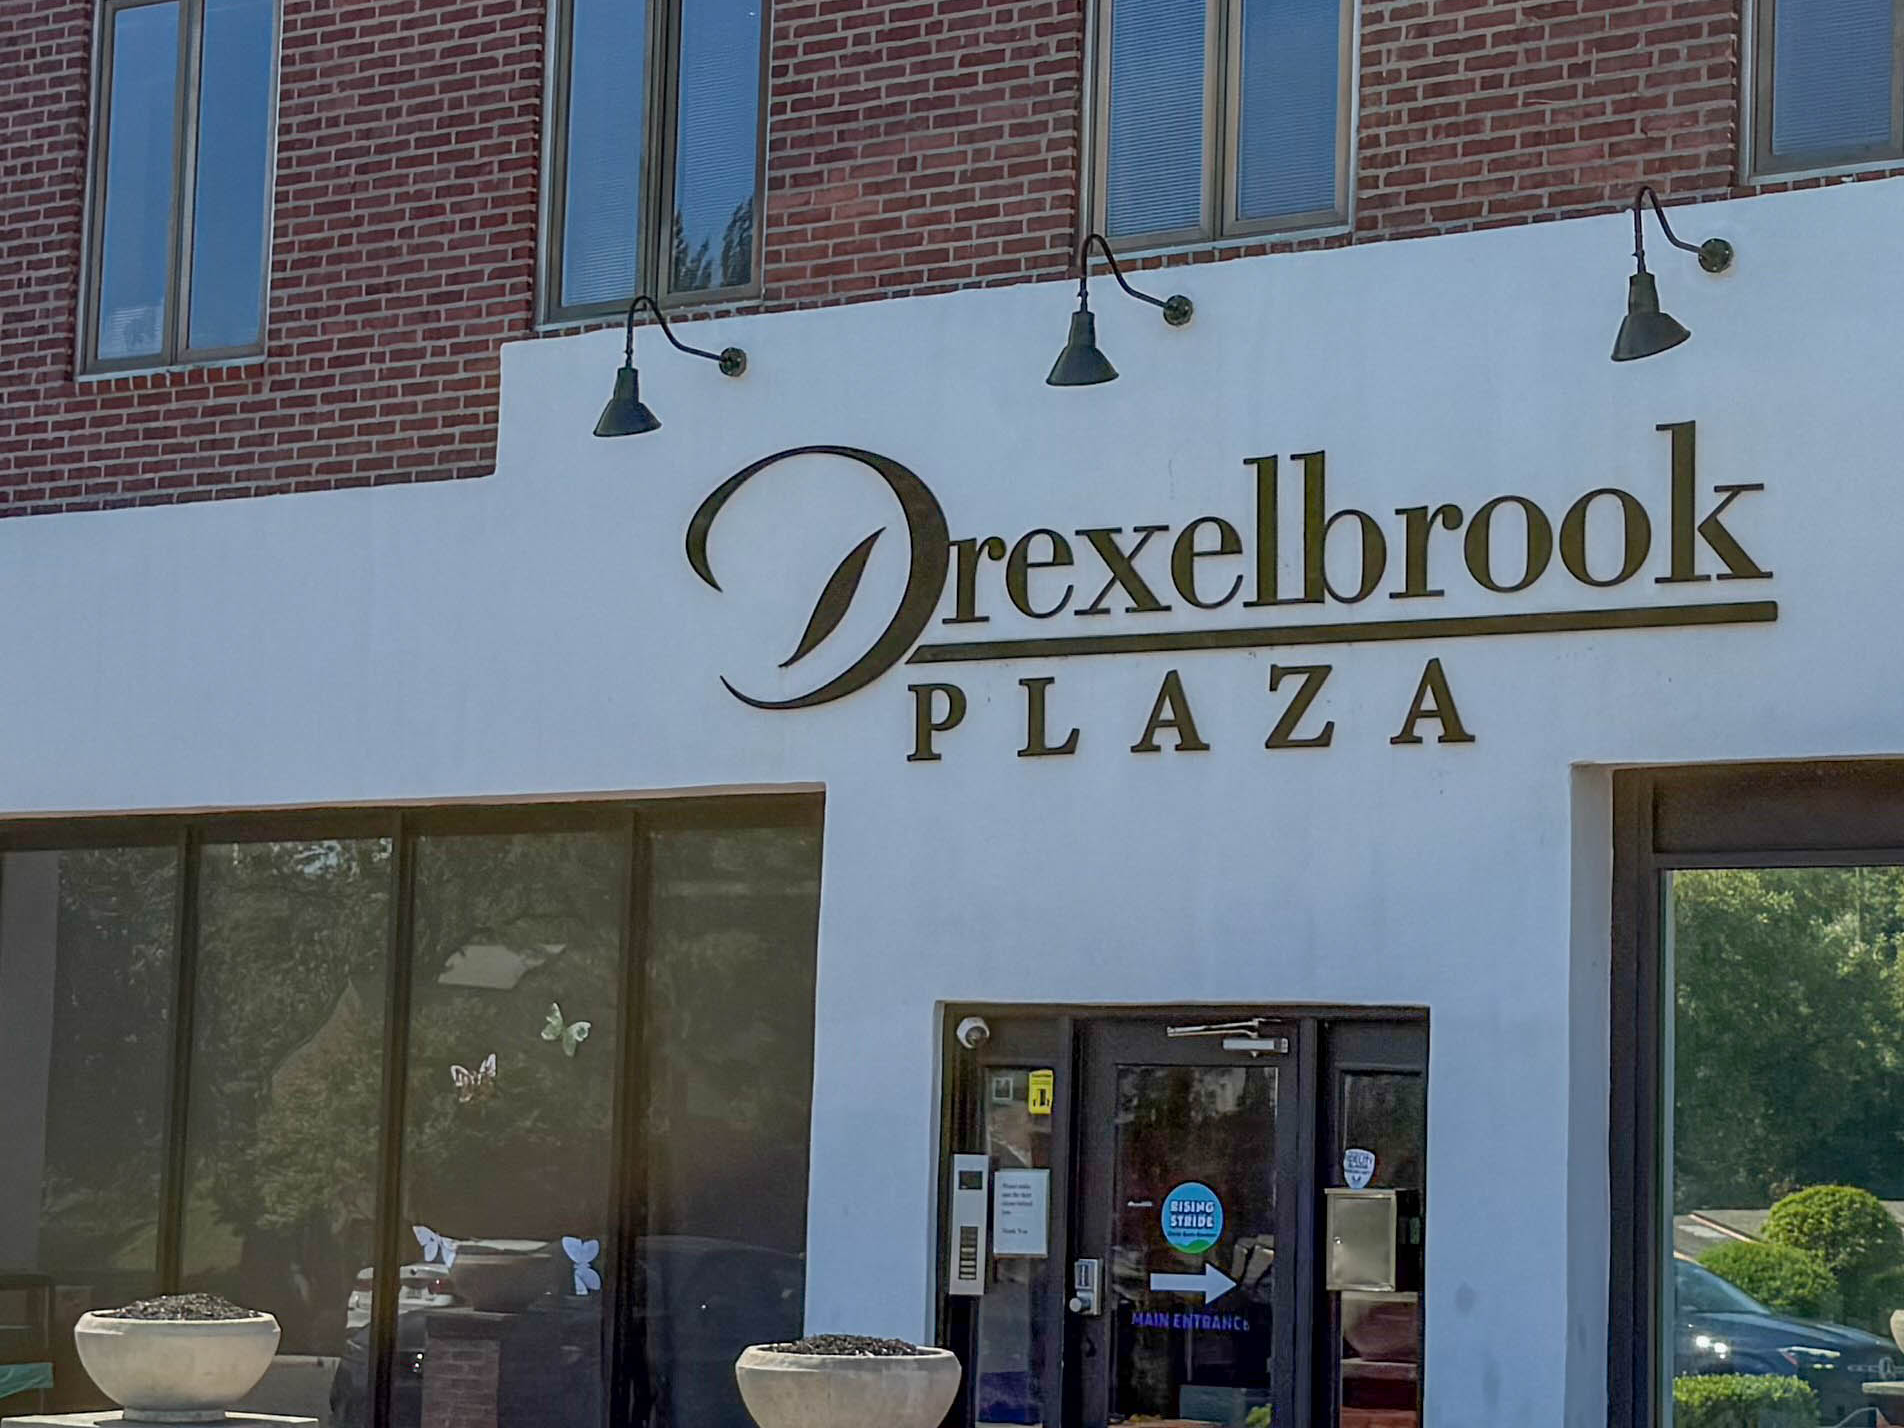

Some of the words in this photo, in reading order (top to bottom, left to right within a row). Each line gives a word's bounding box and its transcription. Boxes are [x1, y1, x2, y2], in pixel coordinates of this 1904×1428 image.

[686, 420, 1773, 711] Drexelbrook
[906, 658, 1475, 762] PLAZA
[1170, 1201, 1215, 1213] RISING
[1170, 1215, 1214, 1228] STRIDE
[1132, 1311, 1170, 1327] MAIN
[1173, 1313, 1250, 1331] ENTRANCE
